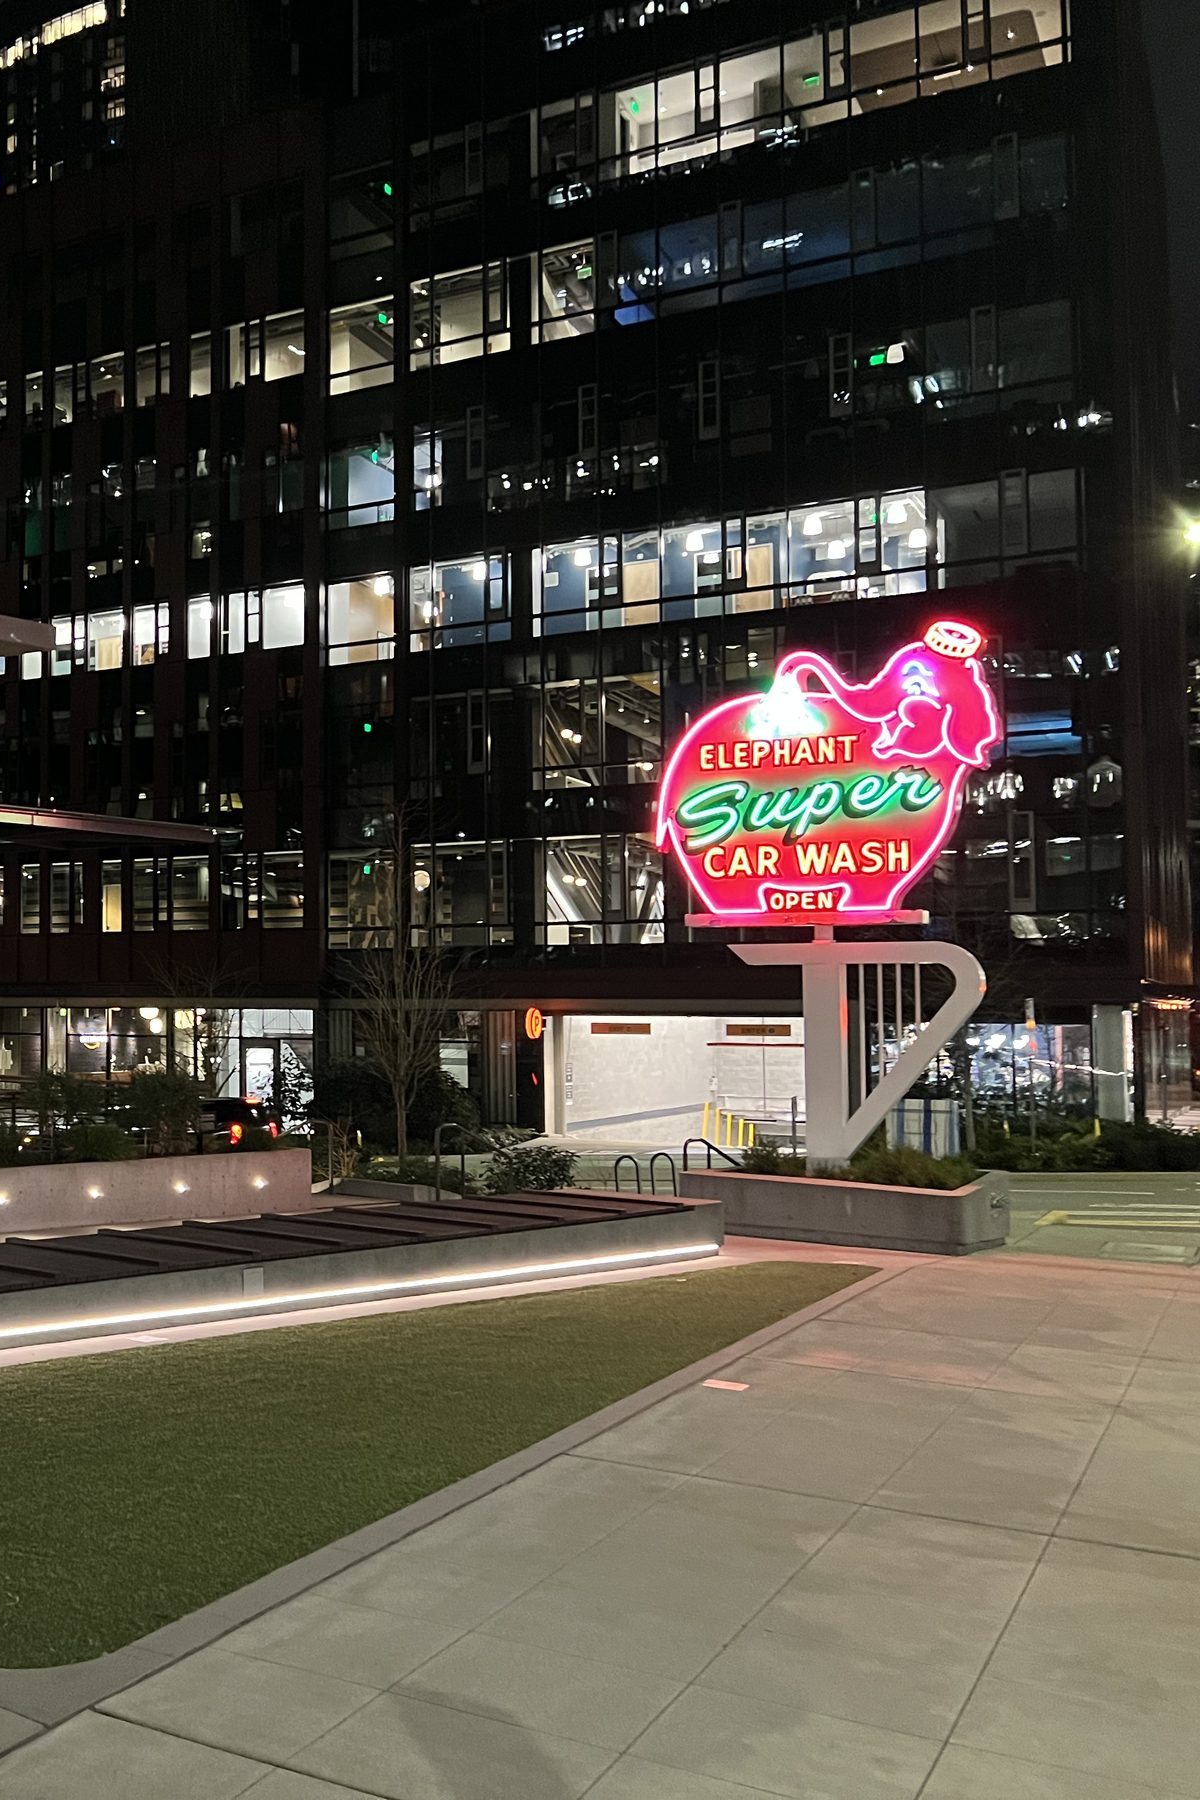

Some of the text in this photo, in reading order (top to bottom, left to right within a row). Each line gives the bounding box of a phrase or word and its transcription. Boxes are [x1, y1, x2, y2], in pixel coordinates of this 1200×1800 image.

[700, 736, 858, 771] ELEPHANT
[677, 766, 942, 853] Super
[703, 840, 909, 878] CAR WASH
[769, 891, 834, 911] OPEN
